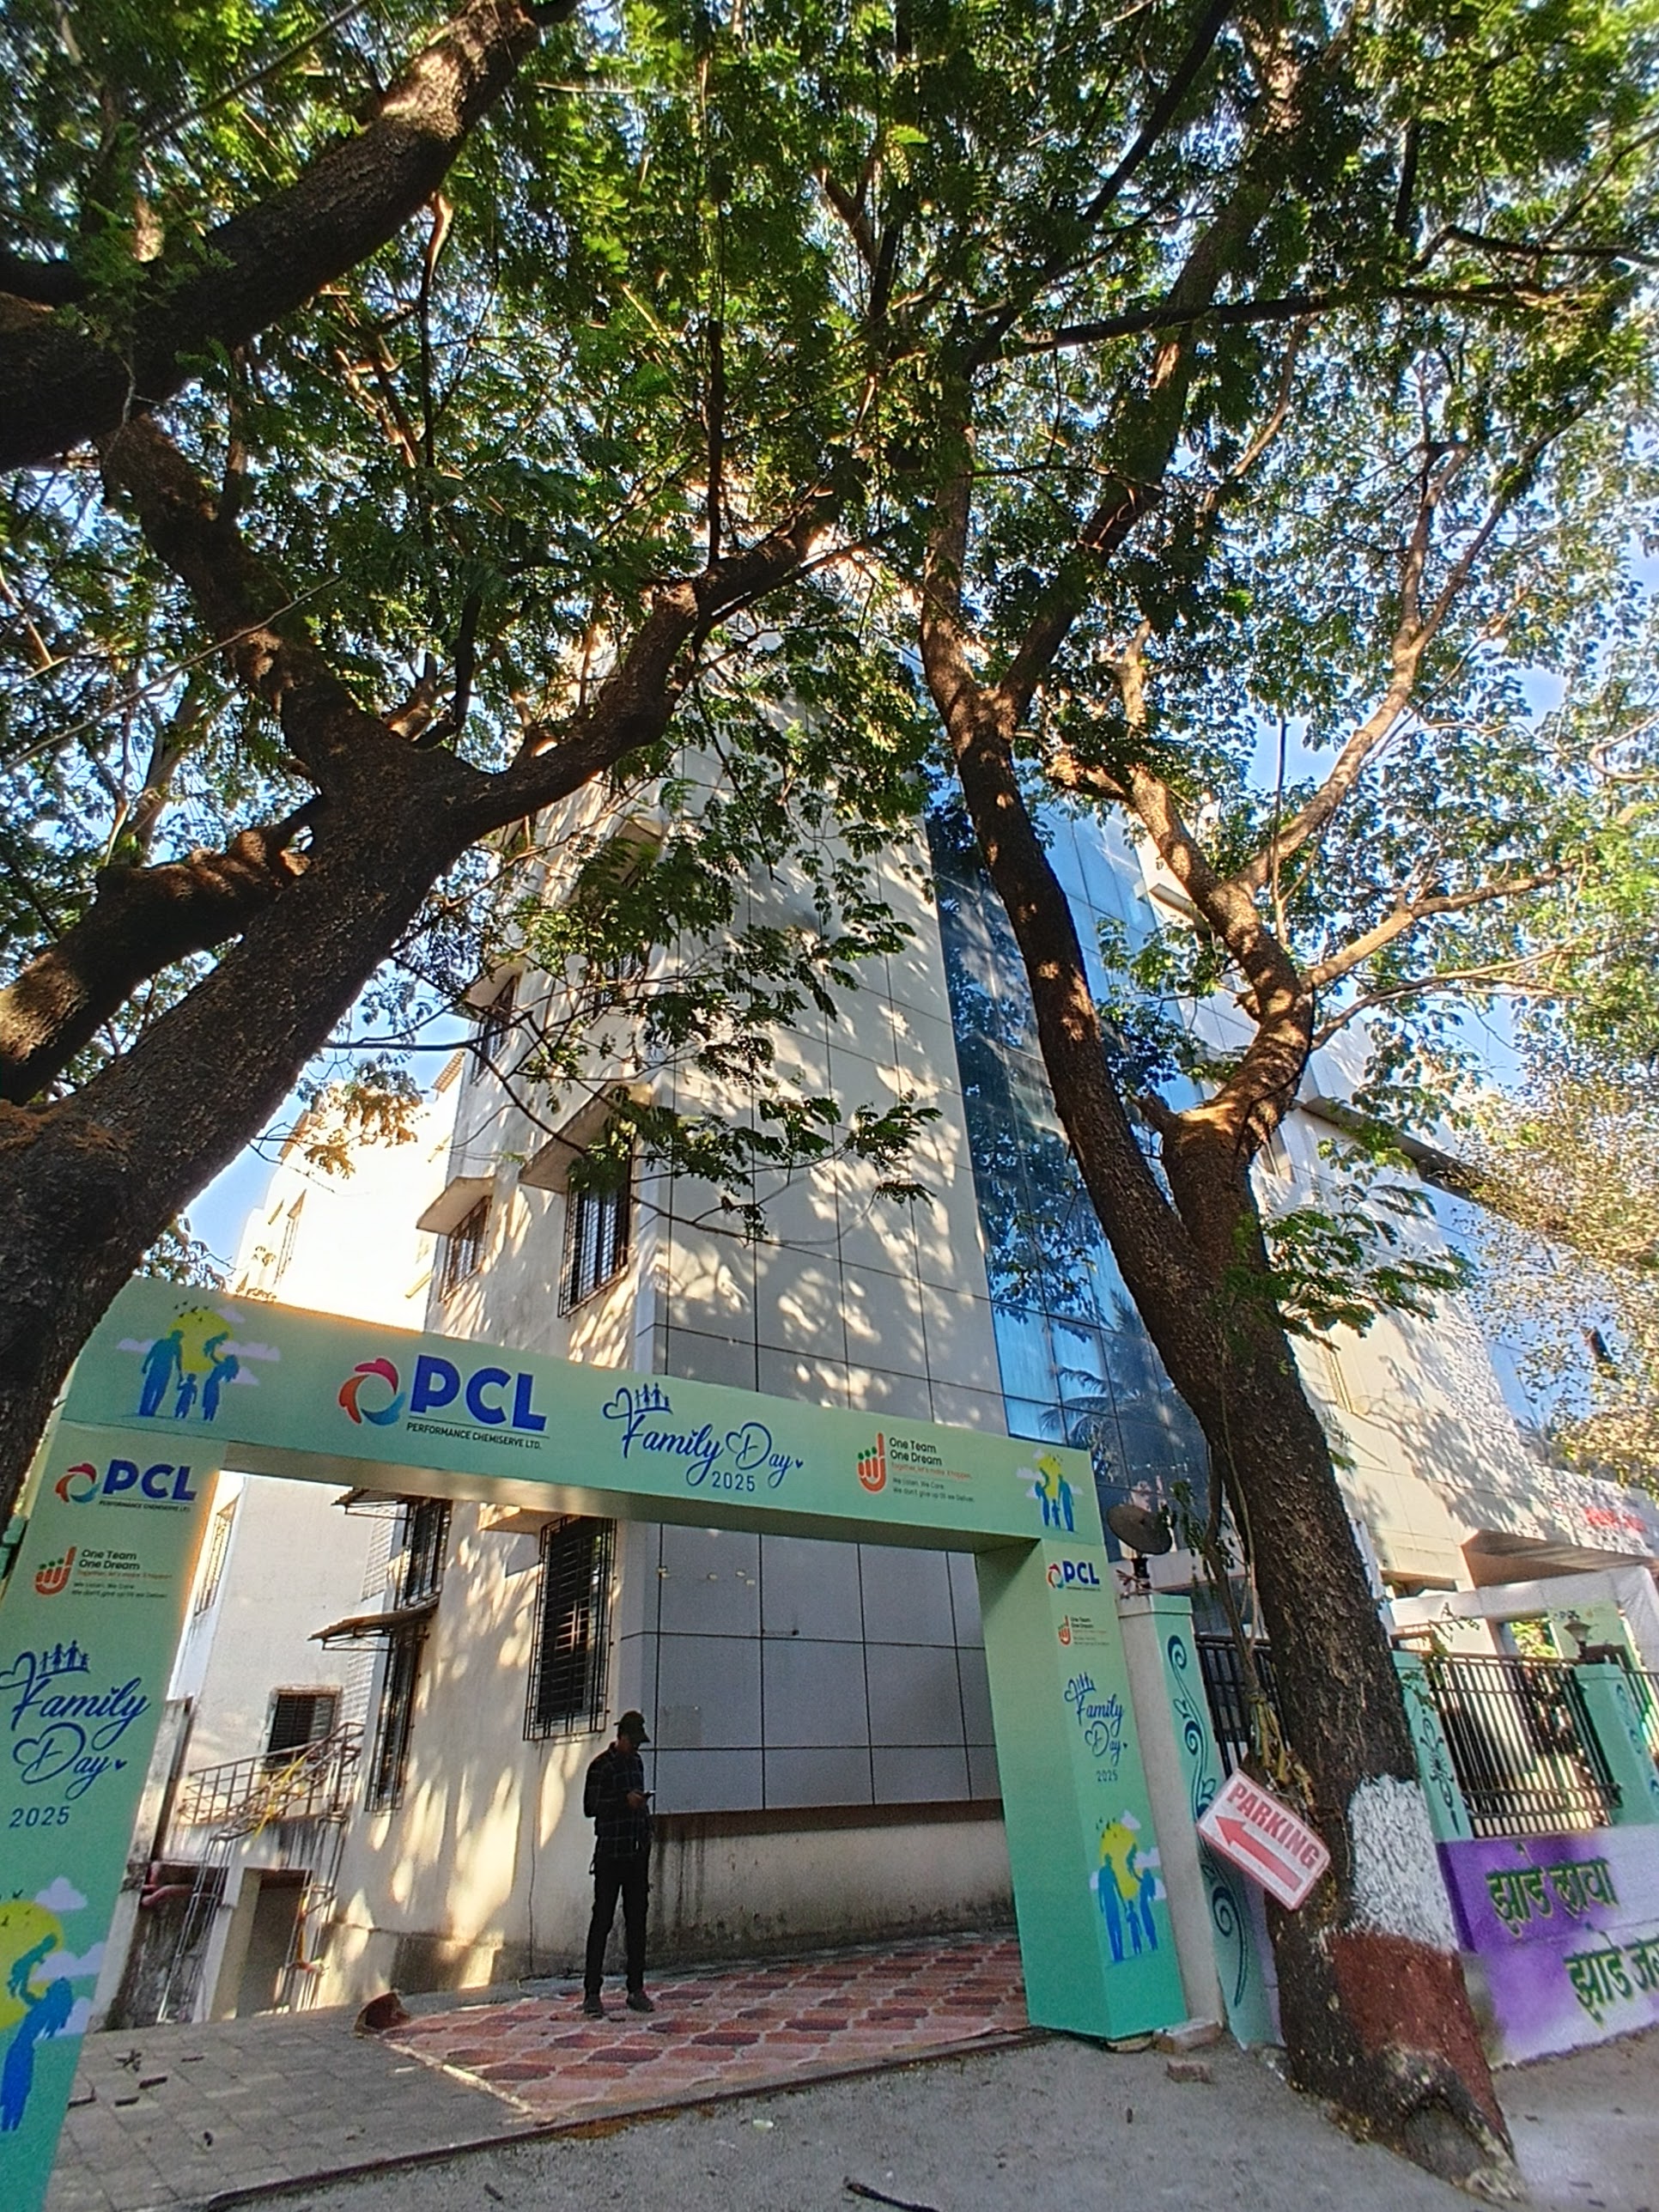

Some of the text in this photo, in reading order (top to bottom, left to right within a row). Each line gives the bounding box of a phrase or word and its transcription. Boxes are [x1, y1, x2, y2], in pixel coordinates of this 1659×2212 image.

[410, 1354, 547, 1431] PCL
[406, 1422, 471, 1440] PERFORMANCE
[472, 1431, 524, 1448] CHEMISERVE
[603, 1388, 793, 1489] Family Day
[890, 1437, 937, 1454] One Team
[890, 1449, 943, 1466] One Dream
[102, 1459, 198, 1501] PCL
[712, 1471, 756, 1492] 2025
[79, 1559, 140, 1571] One Dream
[82, 1549, 137, 1560] One Team
[1062, 1560, 1100, 1584] PCL
[0, 1650, 151, 1751] Family
[1065, 1679, 1124, 1738] Family
[1085, 1720, 1121, 1767] Day
[13, 1722, 112, 1800] Day
[1097, 1769, 1118, 1783] 2025
[9, 1806, 70, 1828] 2025
[1226, 1782, 1320, 1869] PARKING
